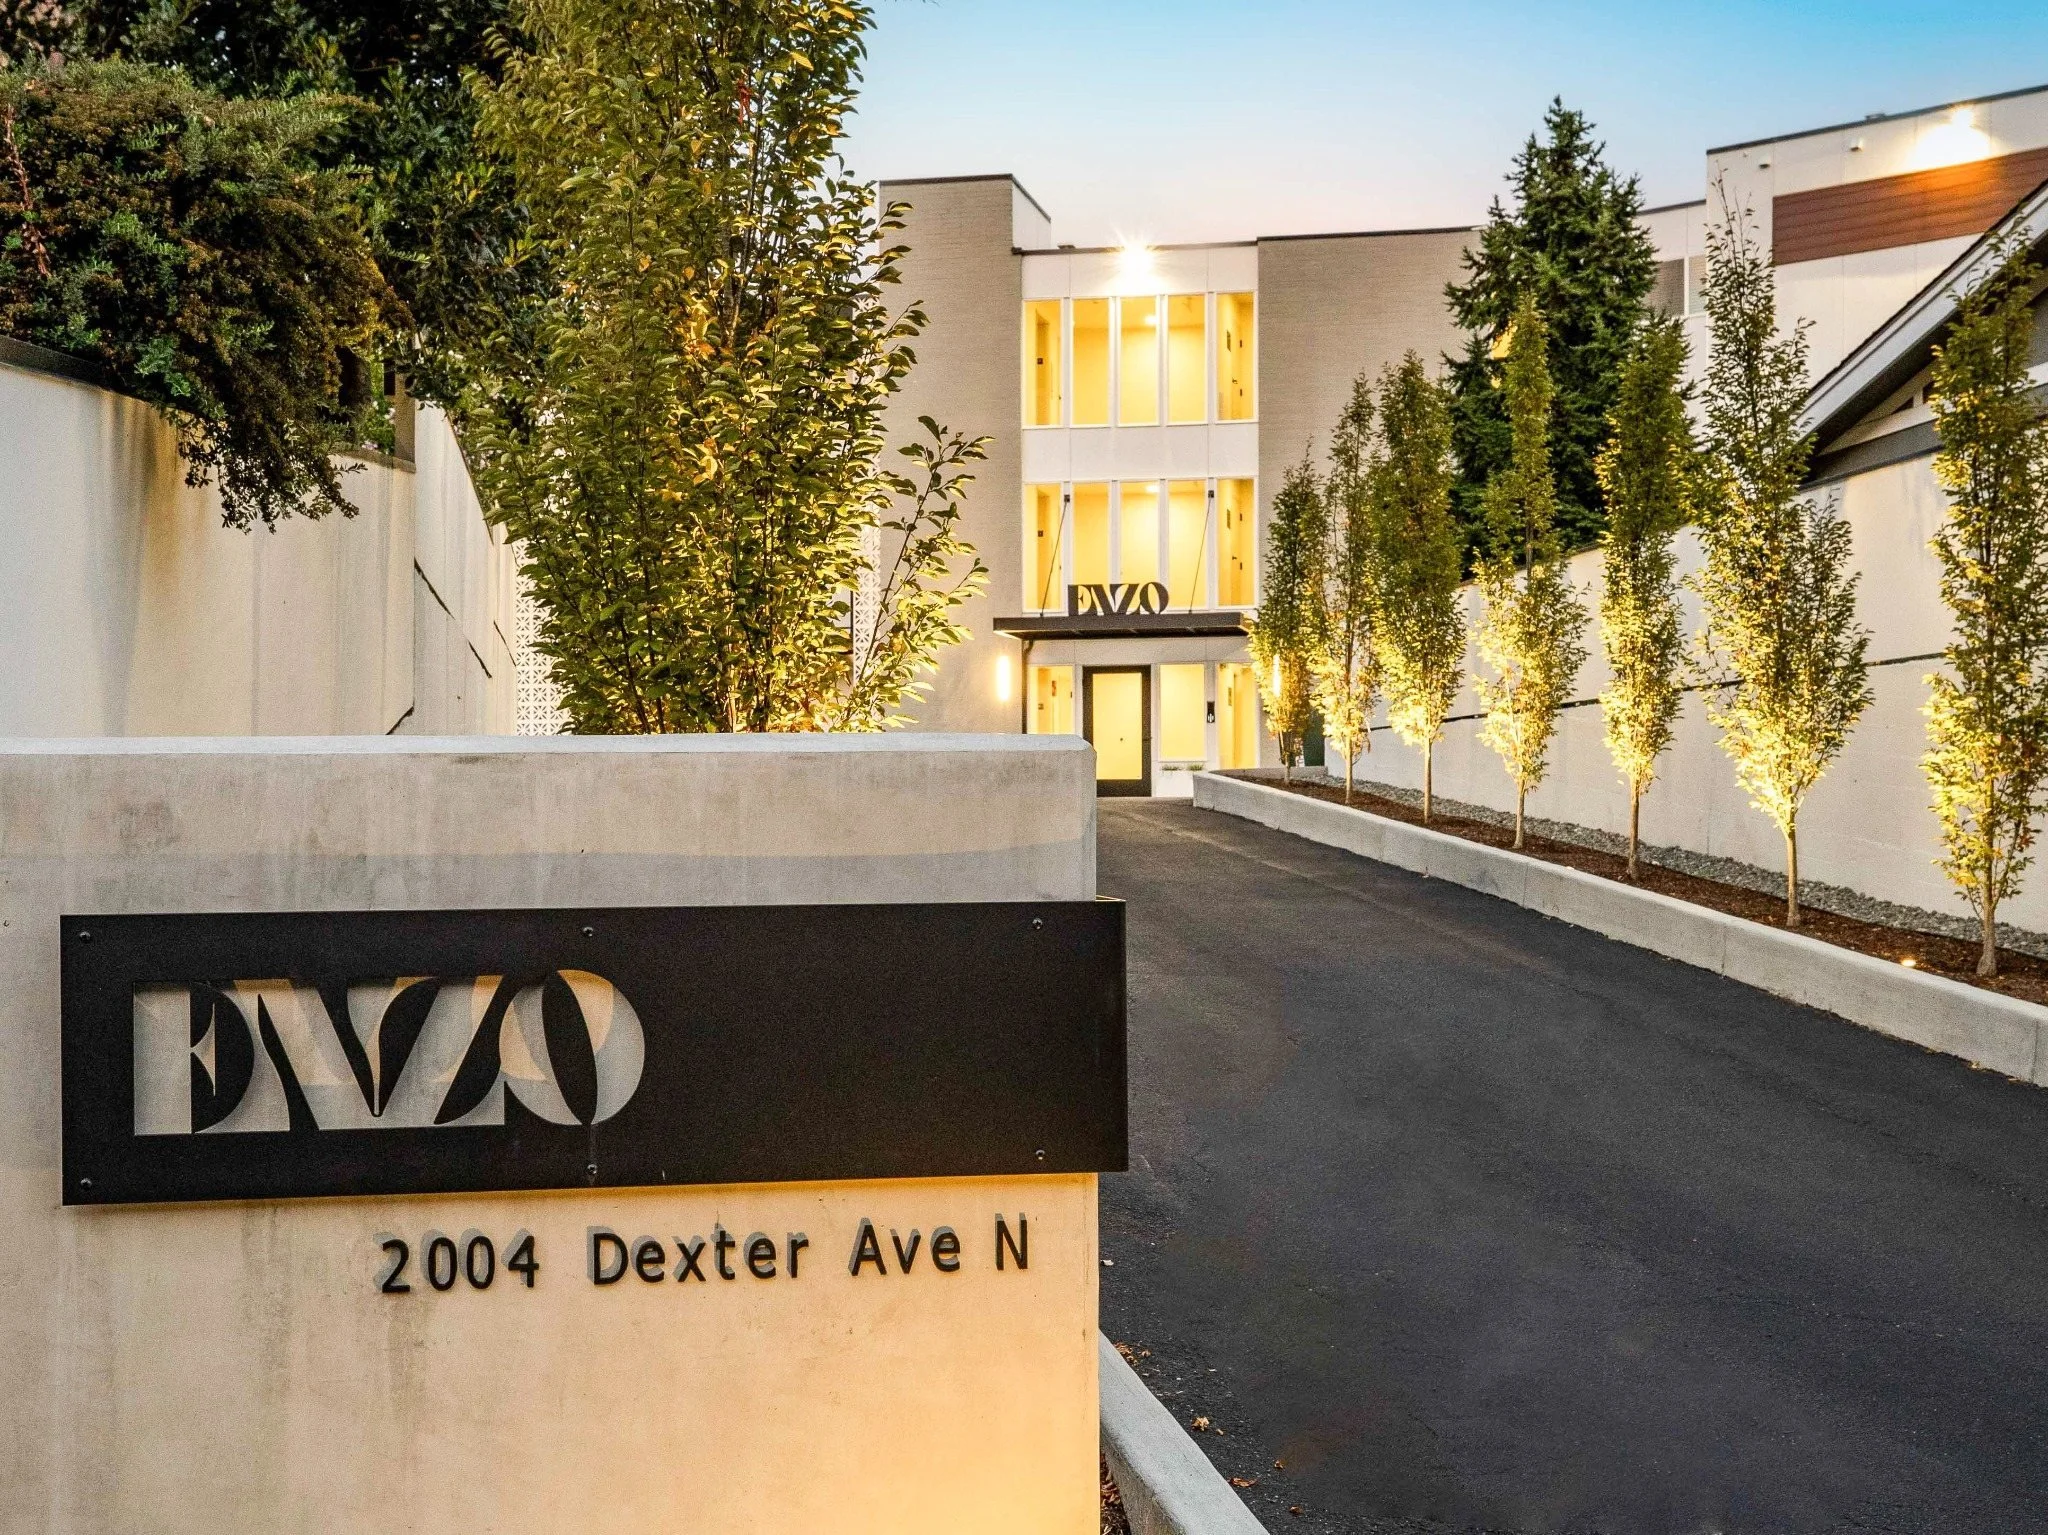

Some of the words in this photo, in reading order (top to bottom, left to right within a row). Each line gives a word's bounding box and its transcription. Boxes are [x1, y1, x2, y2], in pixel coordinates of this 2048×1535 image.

[1067, 582, 1169, 616] ENZO
[133, 969, 645, 1136] ENZO
[380, 1234, 540, 1294] 2004
[592, 1227, 809, 1284] Dexter
[851, 1222, 961, 1276] Ave
[994, 1217, 1029, 1271] N
